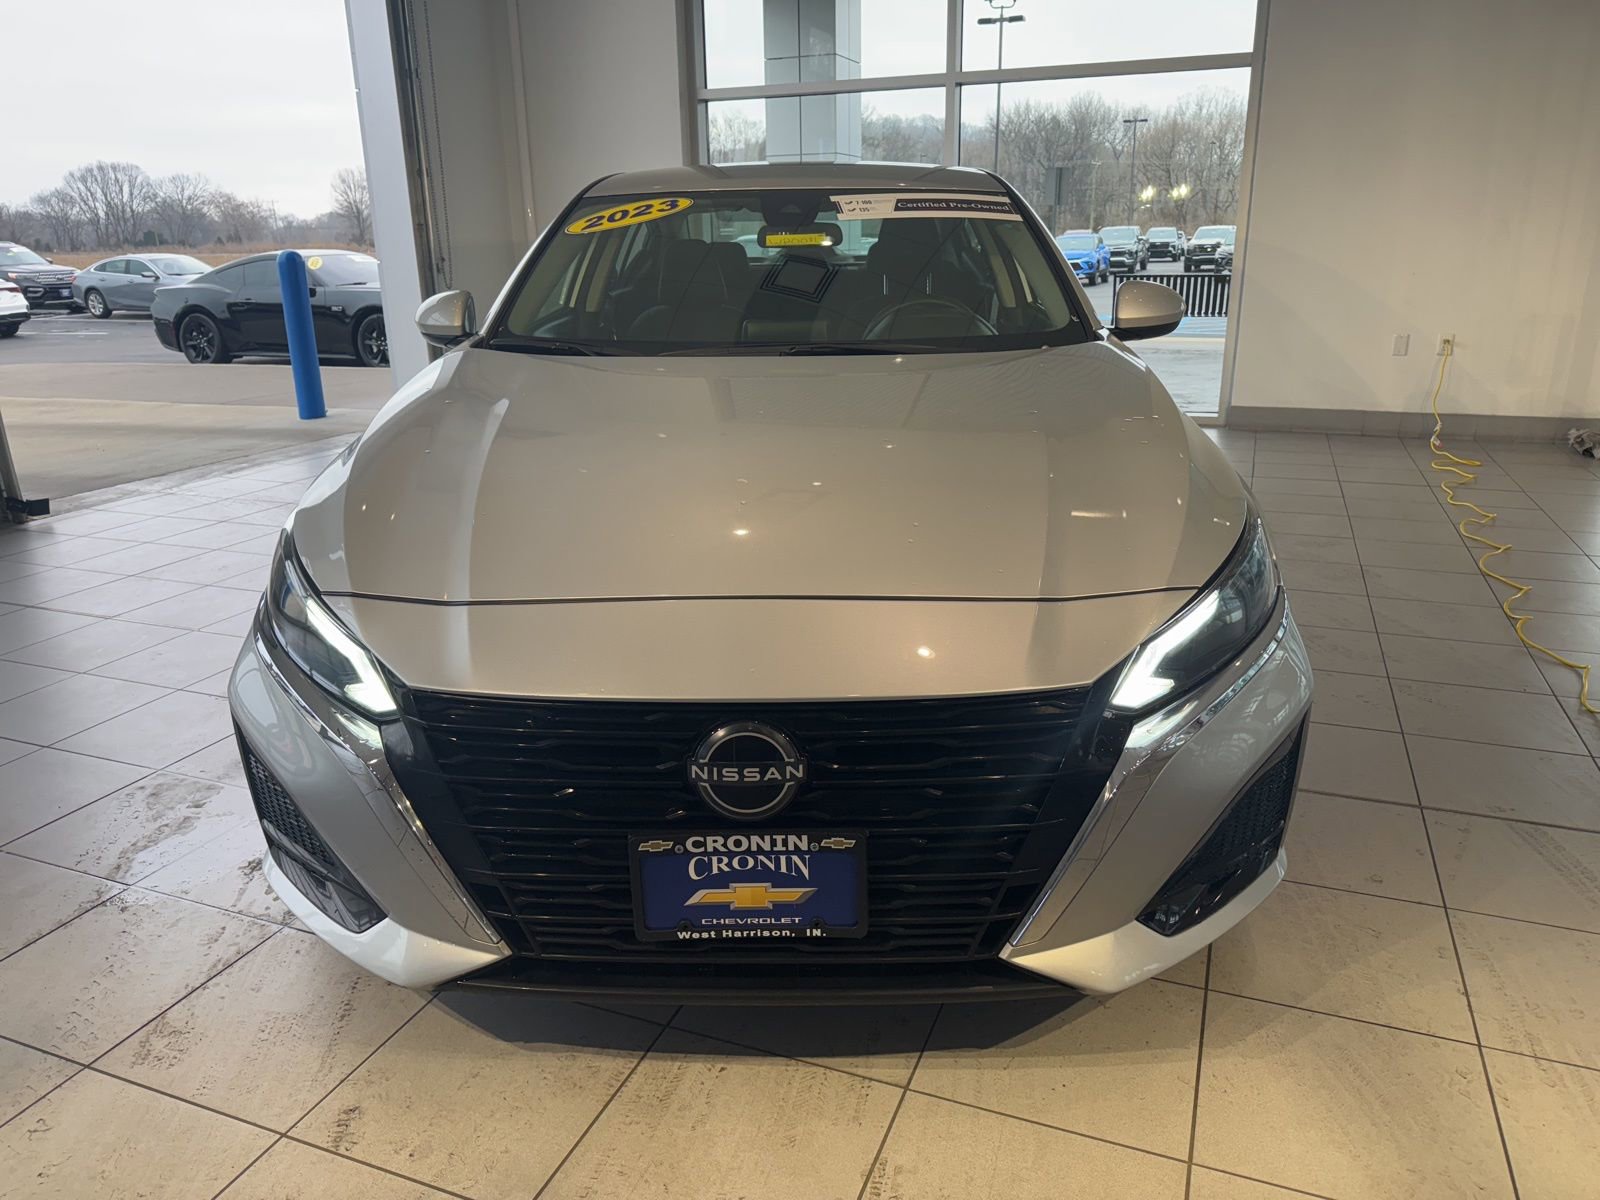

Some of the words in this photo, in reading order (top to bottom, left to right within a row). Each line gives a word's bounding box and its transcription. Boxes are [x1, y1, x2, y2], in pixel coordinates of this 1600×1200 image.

[581, 199, 680, 231] 2023
[949, 202, 1010, 211] Pre-Owned
[691, 764, 804, 782] NISSAN
[685, 834, 808, 853] CRONIN
[688, 854, 811, 881] CRONIN
[701, 917, 802, 925] CHEVROLET
[677, 931, 716, 940] West
[722, 928, 796, 938] Harrison,
[806, 928, 827, 937] IN.
